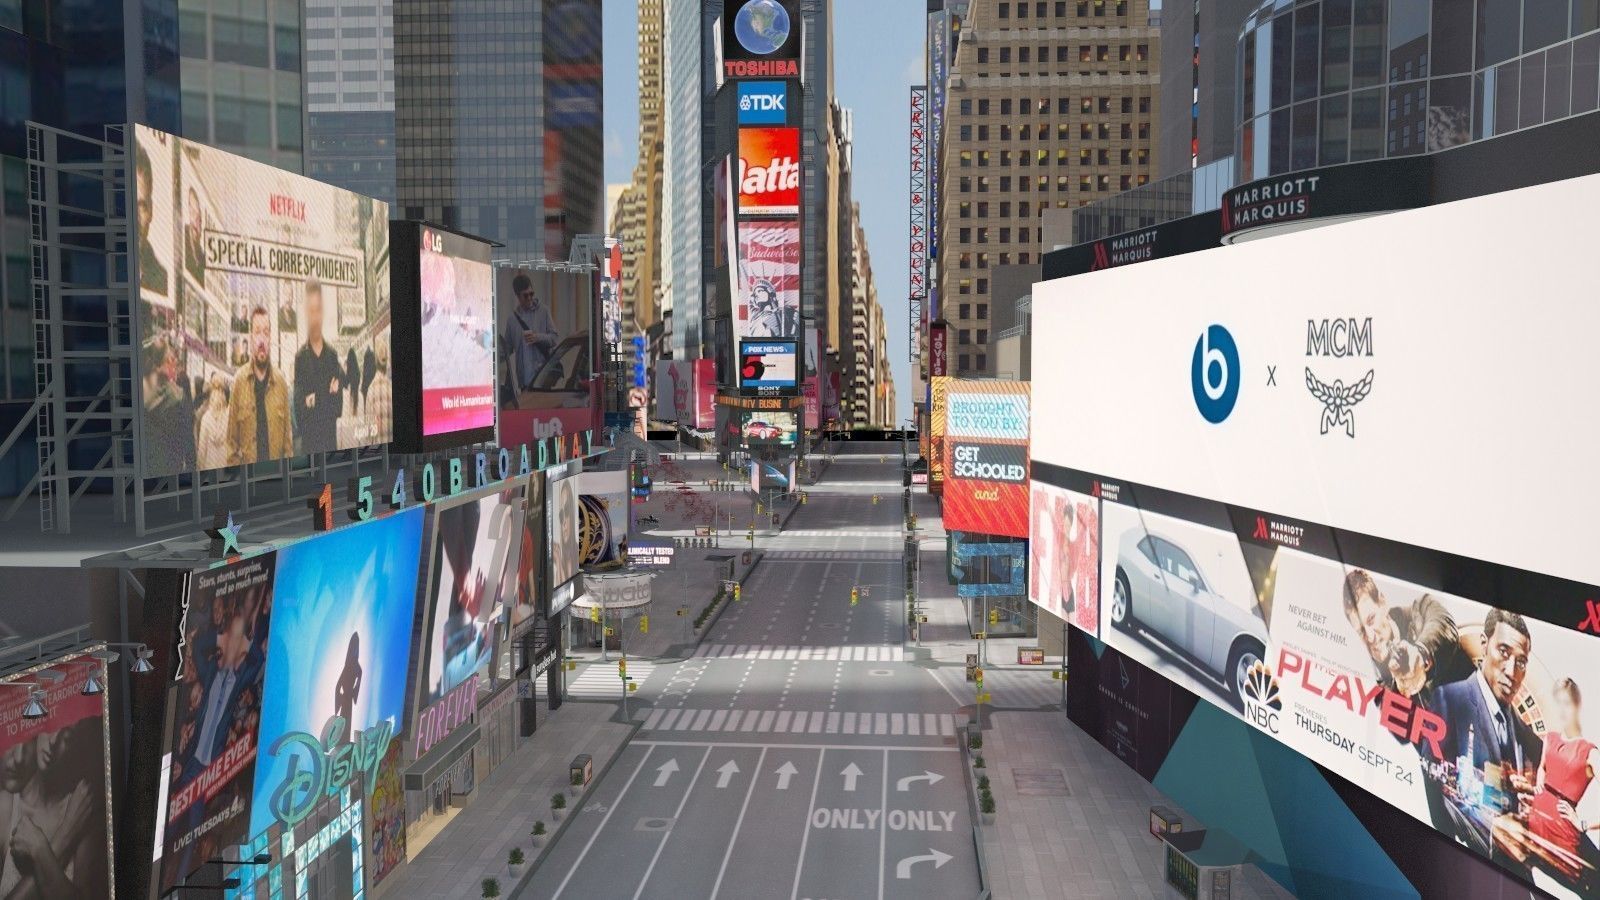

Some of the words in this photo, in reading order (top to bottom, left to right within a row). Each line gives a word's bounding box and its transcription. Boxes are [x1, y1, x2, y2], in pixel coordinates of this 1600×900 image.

[725, 60, 798, 76] TOSHIBA
[750, 94, 784, 111] TDK
[1234, 176, 1320, 208] MARRIOTT
[269, 192, 307, 224] NETFLIX
[1234, 199, 1306, 227] MARQUIS
[431, 231, 443, 253] LG
[748, 242, 799, 259] Budweise
[1112, 230, 1158, 250] MARRIOTT
[207, 238, 266, 271] SPECIAL
[269, 248, 357, 283] CORRESPONDENTS
[1112, 247, 1151, 263] MARQUIS
[1305, 317, 1374, 358] MCM
[748, 345, 763, 353] FOX
[764, 345, 785, 353] NEWS
[953, 401, 1015, 416] BROUGHT
[953, 416, 969, 429] TO
[974, 416, 998, 431] YOU
[954, 445, 980, 462] GET
[954, 461, 1026, 481] SCHOOLED
[974, 487, 999, 500] and
[1101, 482, 1120, 494] MARRIOTT
[1270, 521, 1304, 537] MARRIOTT
[1270, 532, 1300, 546] MARQUIS
[1288, 604, 1313, 620] NEVER
[1312, 612, 1327, 626] BET
[1297, 619, 1330, 639] AGAINST
[1330, 632, 1348, 648] HIM.
[1277, 648, 1447, 762] PLAYER
[1294, 702, 1328, 725] PREMIERES
[415, 673, 481, 761] FOREVER
[1247, 700, 1280, 735] NBC
[1294, 712, 1356, 755] THURSDAY
[1358, 745, 1393, 774] SEPT
[1395, 765, 1414, 787] 24
[168, 780, 196, 824] BEST
[196, 756, 223, 800] TIME
[223, 731, 252, 775] EVER
[173, 831, 193, 854] LIVE!
[193, 806, 230, 839] TUESDAYS
[811, 806, 882, 830] ONLY
[888, 808, 957, 832] ONLY
